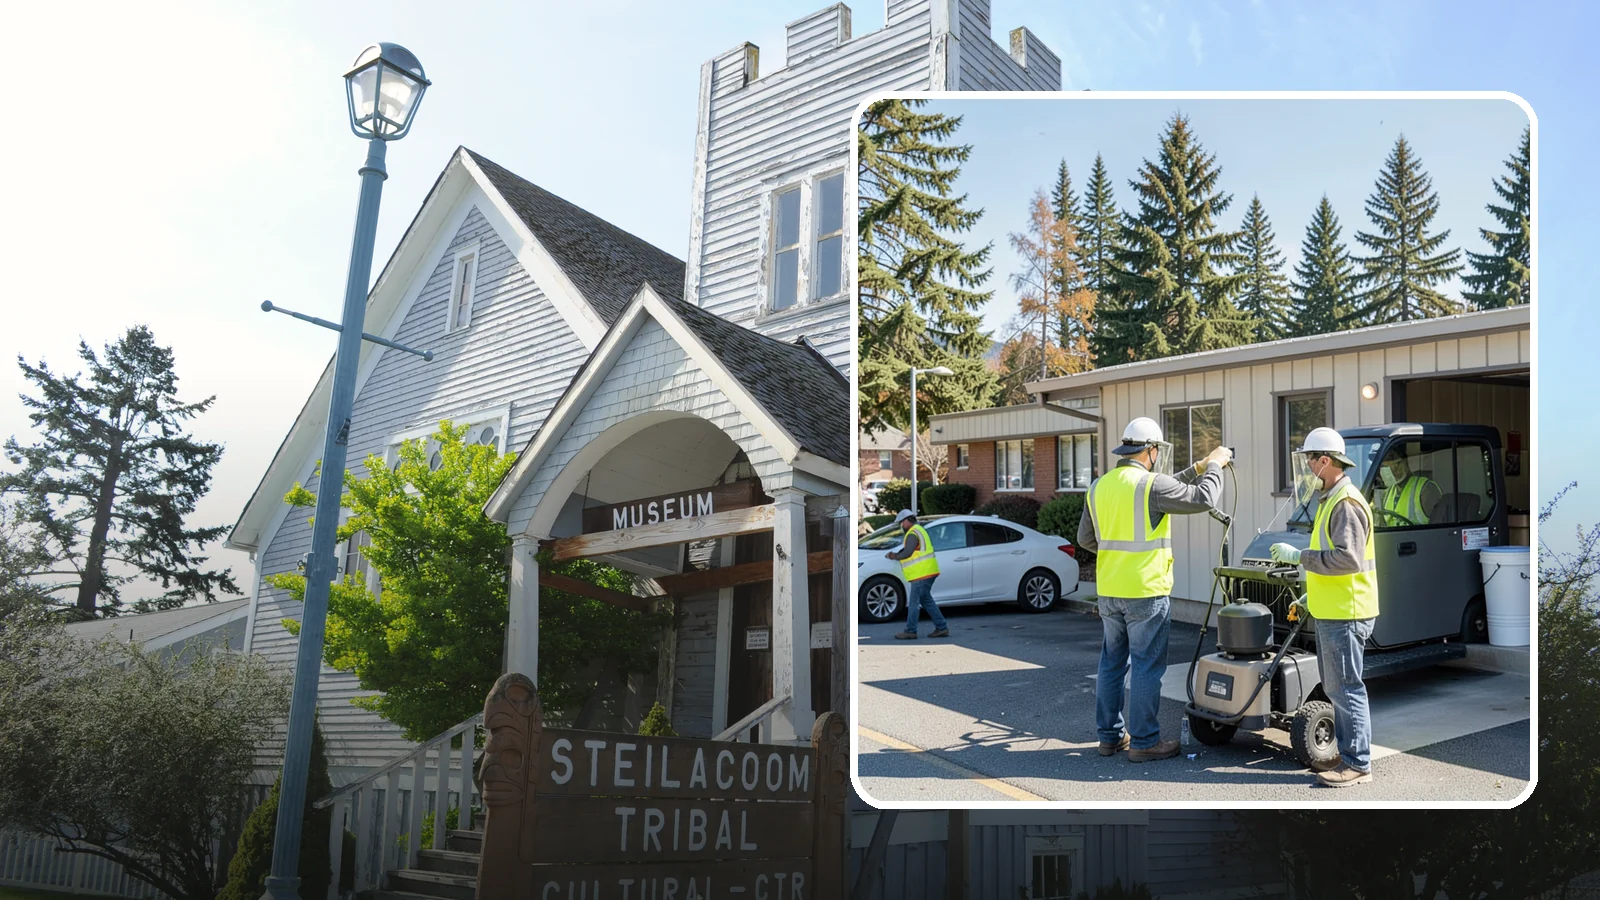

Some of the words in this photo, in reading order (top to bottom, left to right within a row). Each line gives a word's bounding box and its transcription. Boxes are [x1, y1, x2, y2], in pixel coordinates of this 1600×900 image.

[613, 491, 713, 530] MUSEUM
[551, 738, 809, 792] STEILACOOM
[615, 807, 757, 851] TRIBAL
